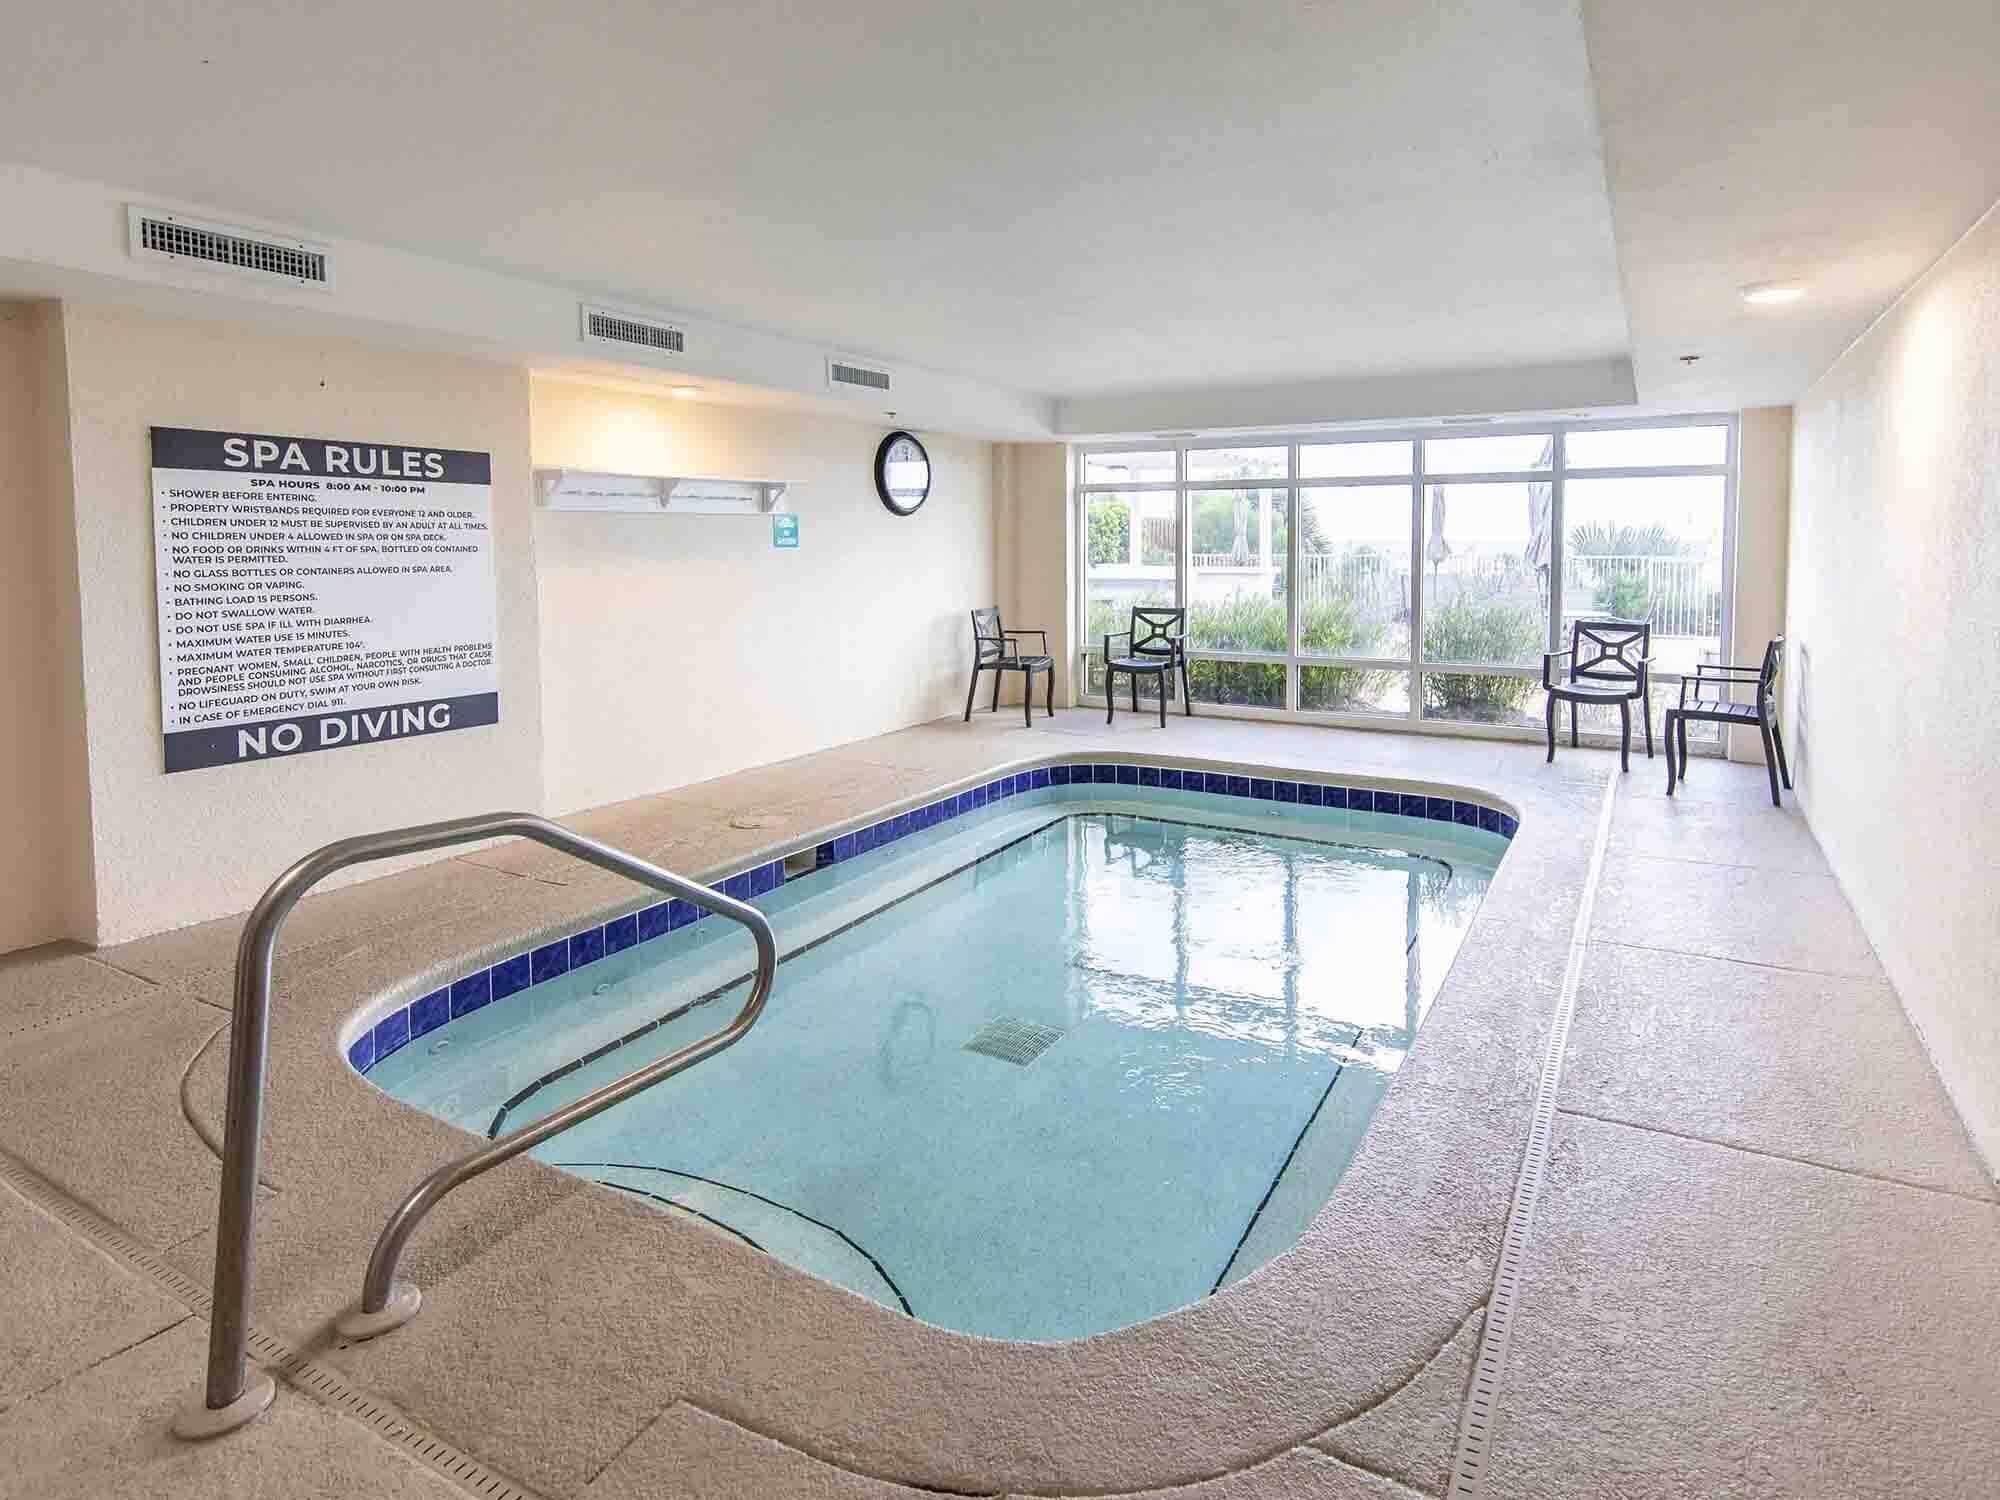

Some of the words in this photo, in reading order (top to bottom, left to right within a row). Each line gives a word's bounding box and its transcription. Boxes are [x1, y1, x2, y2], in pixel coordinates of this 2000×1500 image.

[223, 438, 311, 472] SPA
[326, 445, 444, 478] RULES
[250, 479, 275, 487] SPA
[278, 480, 319, 488] HOURS
[169, 489, 219, 498] SHOWER
[222, 491, 263, 500] BEFORE
[170, 503, 228, 512] PROPERTY
[232, 505, 299, 514] WRISTBANDS
[301, 507, 349, 515] REQUIRED
[170, 517, 226, 526] CHILDREN
[171, 531, 188, 539] NO
[191, 532, 246, 540] CHILDREN
[172, 545, 189, 554] NO
[192, 545, 224, 553] FOOD
[172, 555, 212, 563] WATER
[215, 555, 224, 563] IS
[173, 570, 190, 578] NO
[193, 569, 228, 577] GLASS
[231, 568, 276, 576] BOTTLES
[174, 584, 191, 592] NO
[193, 582, 244, 591] SMOKING
[174, 596, 223, 606] BATHING
[226, 595, 254, 604] LOAD
[270, 593, 317, 602] PERSONS.
[175, 612, 192, 620] DO
[195, 610, 218, 619] NOT
[220, 608, 275, 617] SWALLOW
[175, 625, 194, 634] DO
[196, 624, 219, 632] NOT
[222, 623, 242, 631] USE
[245, 622, 265, 630] SPA
[176, 637, 231, 647] MAXIMUM
[234, 634, 271, 644] WATER
[274, 633, 292, 641] USE
[307, 630, 350, 639] MINUTES.
[176, 651, 232, 661] MAXIMUM
[235, 648, 271, 657] WATER
[273, 642, 343, 654] TEMPERATURE
[177, 664, 234, 675] PREGNANT
[282, 658, 313, 667] SMALL
[365, 650, 396, 659] PEOPLE
[422, 646, 451, 654] HEALTH
[453, 642, 492, 653] PROBLEMS
[177, 677, 201, 686] AND
[205, 673, 244, 683] PEOPLE
[248, 667, 306, 679] CONSUMING
[406, 657, 418, 666] OR
[420, 654, 446, 664] DRUGS
[448, 652, 466, 663] THAT
[469, 650, 493, 661] CAUSE
[178, 683, 245, 696] DROWSINESS
[247, 679, 286, 689] SHOULD
[288, 676, 306, 685] NOT
[309, 674, 325, 683] USE
[346, 669, 384, 679] WITHOUT
[386, 666, 406, 675] FIRST
[408, 662, 453, 672] CONSULTING
[178, 701, 196, 710] NO
[199, 695, 258, 708] LIFEGUARD
[260, 692, 276, 701] ON
[309, 687, 335, 696] SWIM
[338, 684, 348, 692] AT
[351, 682, 375, 691] YOUR
[377, 680, 399, 688] OWN
[179, 716, 190, 724] IN
[193, 712, 222, 722] CASE
[225, 710, 240, 718] OF
[242, 703, 304, 716] EMERGENCY
[307, 700, 328, 709] DIAL
[238, 723, 302, 758] NO
[320, 703, 450, 746] DIVING
